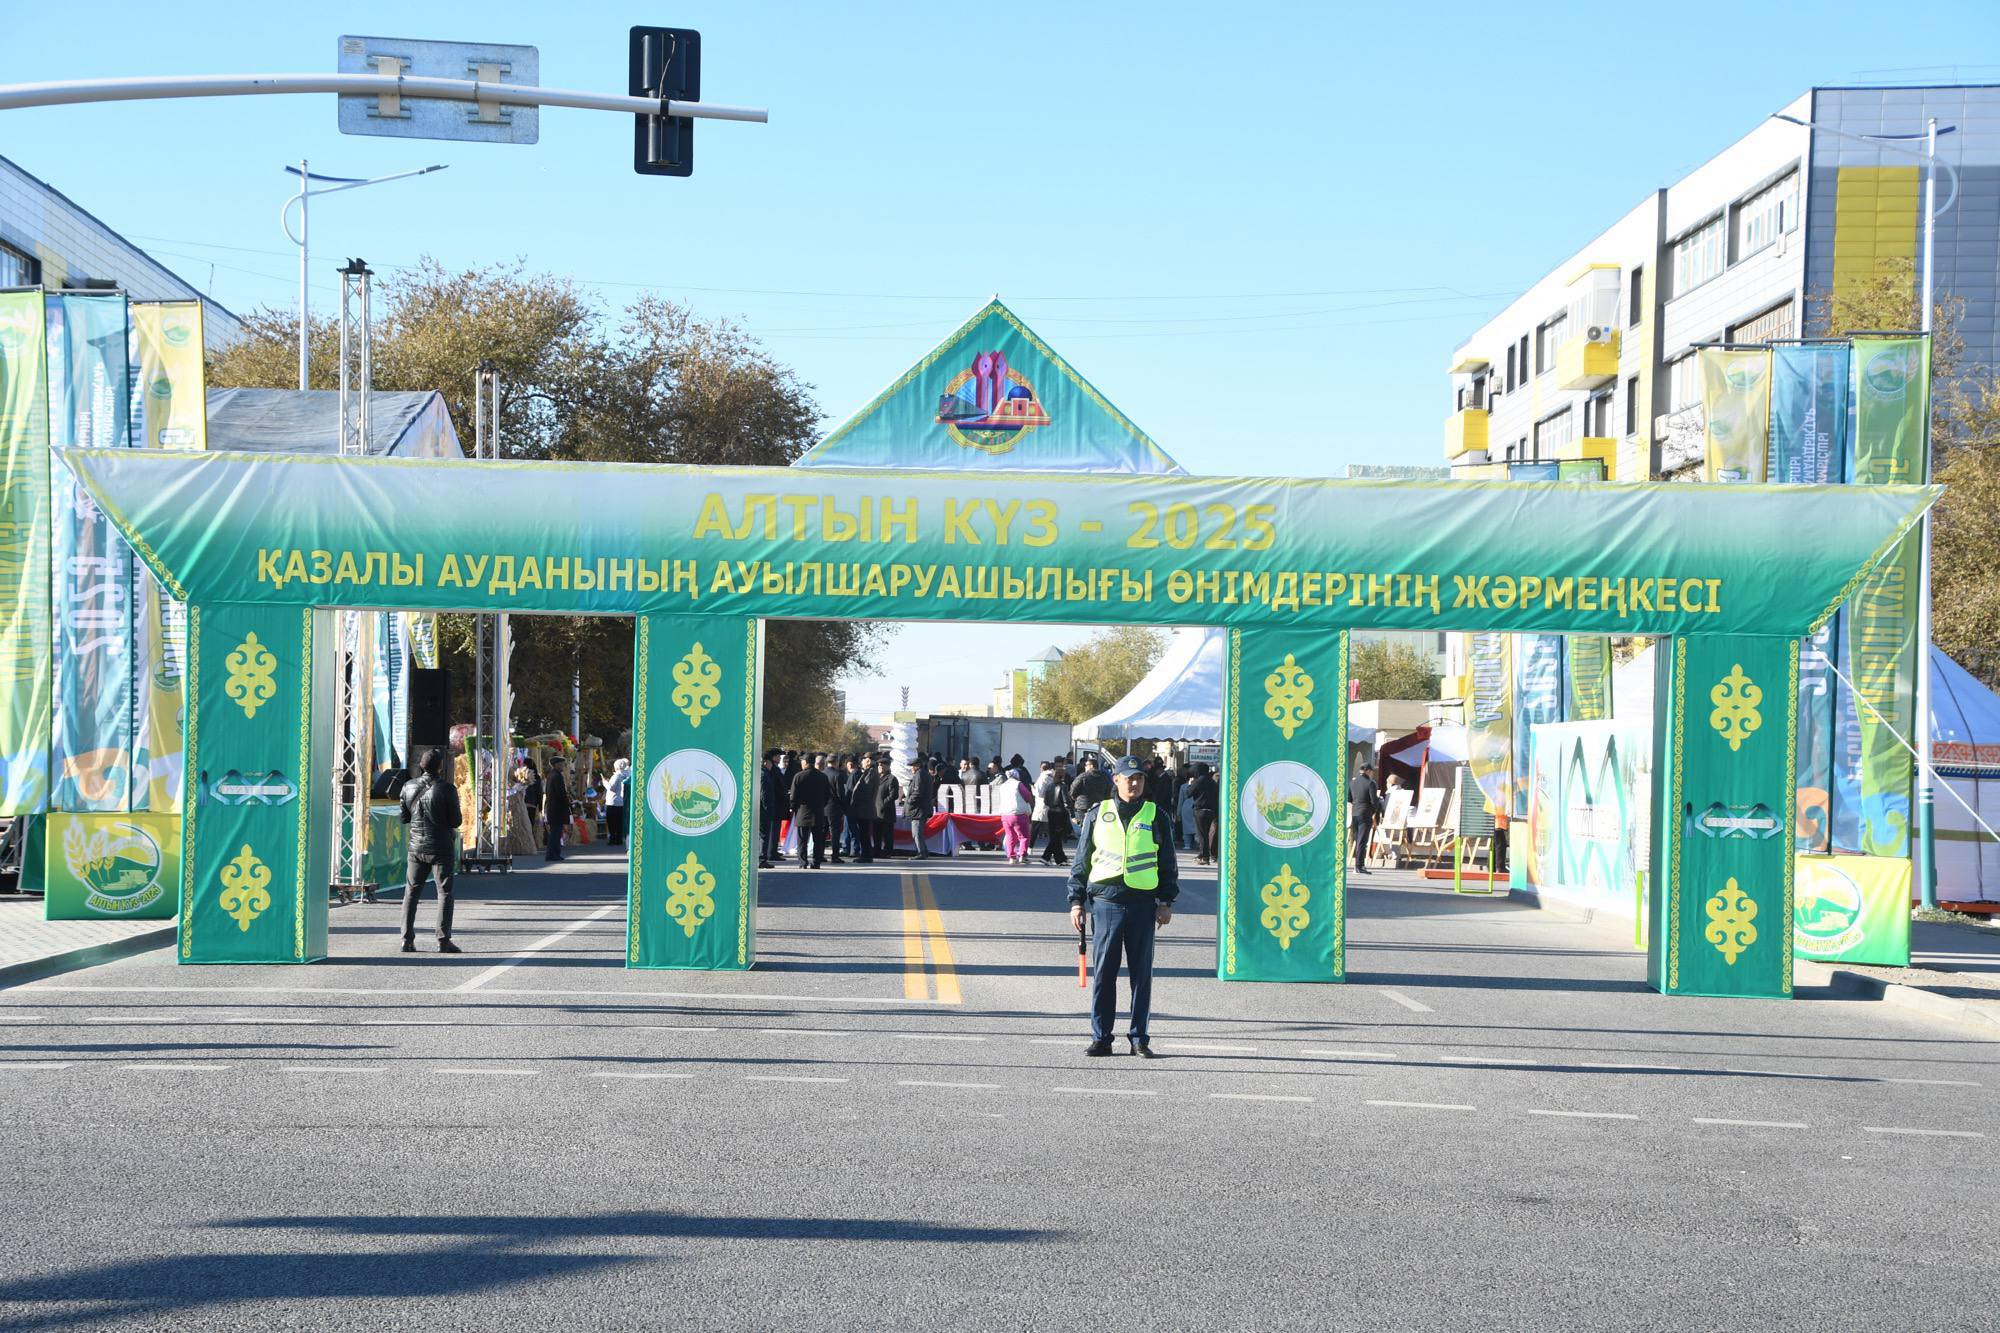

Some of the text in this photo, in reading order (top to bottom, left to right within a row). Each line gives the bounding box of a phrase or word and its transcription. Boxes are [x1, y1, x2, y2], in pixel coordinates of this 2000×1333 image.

[694, 493, 1278, 552] АЛТЫН КҮЗ - 2025
[258, 548, 1722, 618] ҚАЗАЛЫ АУДАНЫНЫҢ АУЫЛШАРУАШЫЛЫҒЫ ӨНІМДЕРІНІҢ ЖӘРМЕҢКЕСІ
